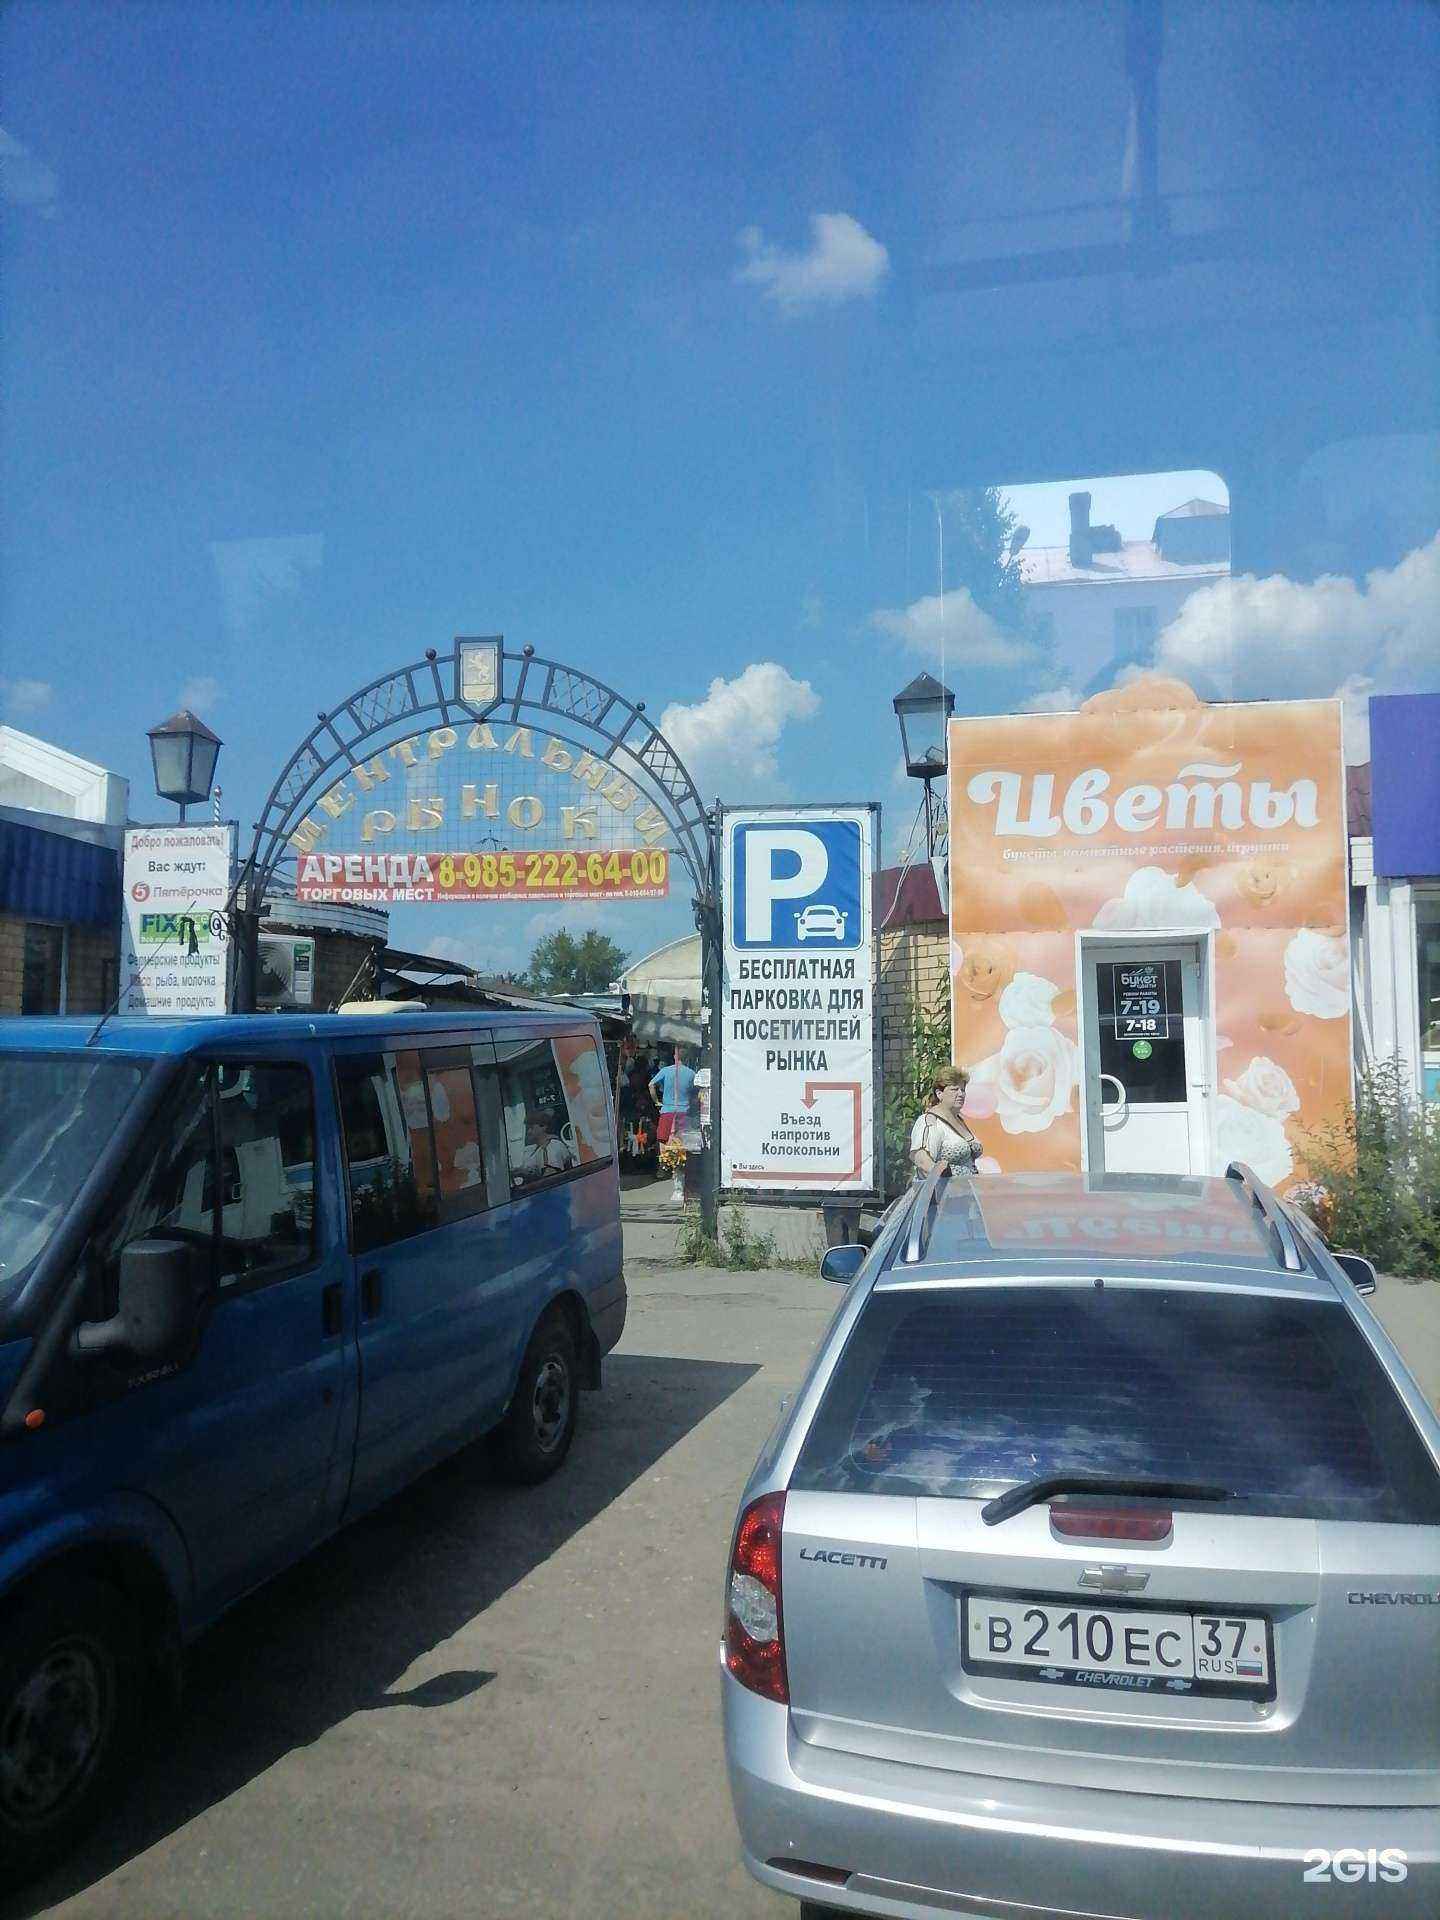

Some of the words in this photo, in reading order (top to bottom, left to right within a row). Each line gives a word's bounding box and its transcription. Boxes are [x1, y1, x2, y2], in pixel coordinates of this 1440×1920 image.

[967, 762, 1320, 837] Цветы
[360, 784, 599, 844] РЫНОК
[131, 835, 160, 850] Добро
[148, 860, 170, 873] Вас
[174, 861, 206, 875] ждут:
[301, 855, 435, 888] АРЕНДА
[438, 852, 666, 888] 8-985-222-64-00
[153, 885, 223, 902] Пятёрочка
[746, 830, 828, 941] P
[302, 888, 389, 901] ТОРГОВЫХ
[392, 888, 435, 901] МЕСТ
[179, 954, 220, 969] продукты
[739, 958, 855, 980] БЕСПЛАТНАЯ
[181, 975, 216, 987] молочка
[128, 994, 172, 1010] Домашние
[176, 995, 216, 1010] продукты
[730, 989, 823, 1010] ПАРКОВКА
[827, 989, 864, 1013] ДЛЯ
[1120, 1000, 1161, 1015] 7-19
[733, 1015, 861, 1041] ПОСЕТИТЕЛЕЙ
[1126, 1018, 1157, 1032] 7-18
[766, 1050, 829, 1071] РЫНКА
[780, 1112, 822, 1127] Въезд
[771, 1130, 831, 1143] напротив
[761, 1143, 840, 1156] Колокольни
[799, 1547, 889, 1570] LACETTI
[1348, 1592, 1440, 1605] CHEVROL
[1199, 1618, 1247, 1658] 37
[1198, 1658, 1235, 1674] RUS
[1075, 1671, 1155, 1688] CHEVROLET
